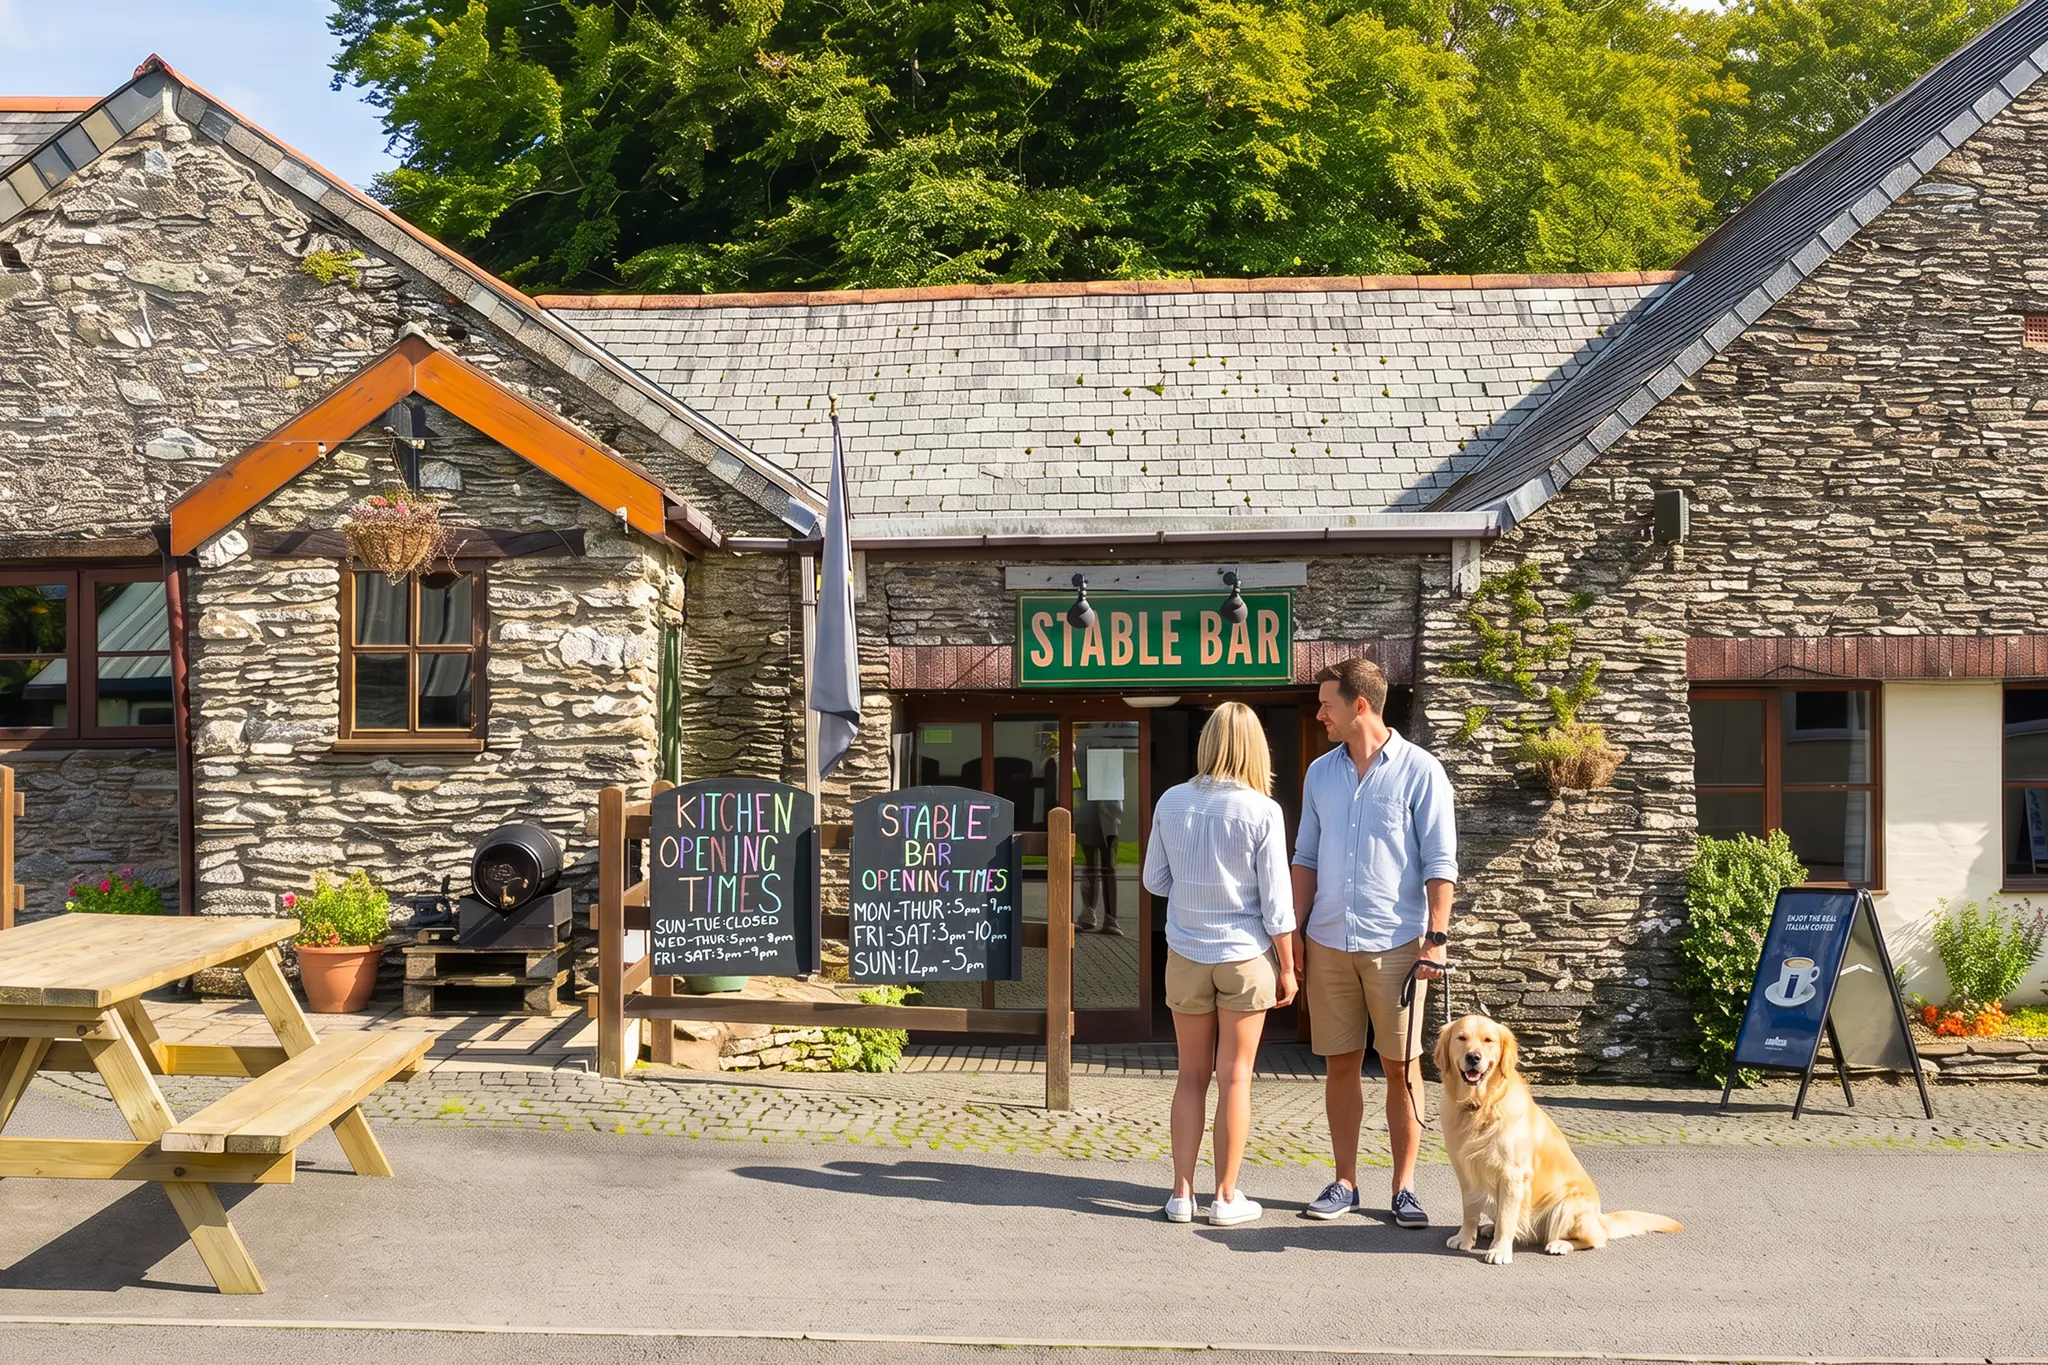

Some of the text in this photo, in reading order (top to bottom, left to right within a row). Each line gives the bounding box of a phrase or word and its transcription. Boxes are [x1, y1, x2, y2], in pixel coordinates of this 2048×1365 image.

[1030, 609, 1281, 668] STABLE BAR
[676, 792, 794, 834] KITCHEN
[881, 803, 991, 840] STABLE
[659, 834, 779, 874] OPENING
[905, 839, 952, 867] BAR
[678, 873, 782, 914] TIMES
[861, 868, 1008, 893] OPENING TIMES
[1785, 923, 1835, 931] ITALIAN COFFEE
[1787, 914, 1837, 922] ENJOY THE REAL
